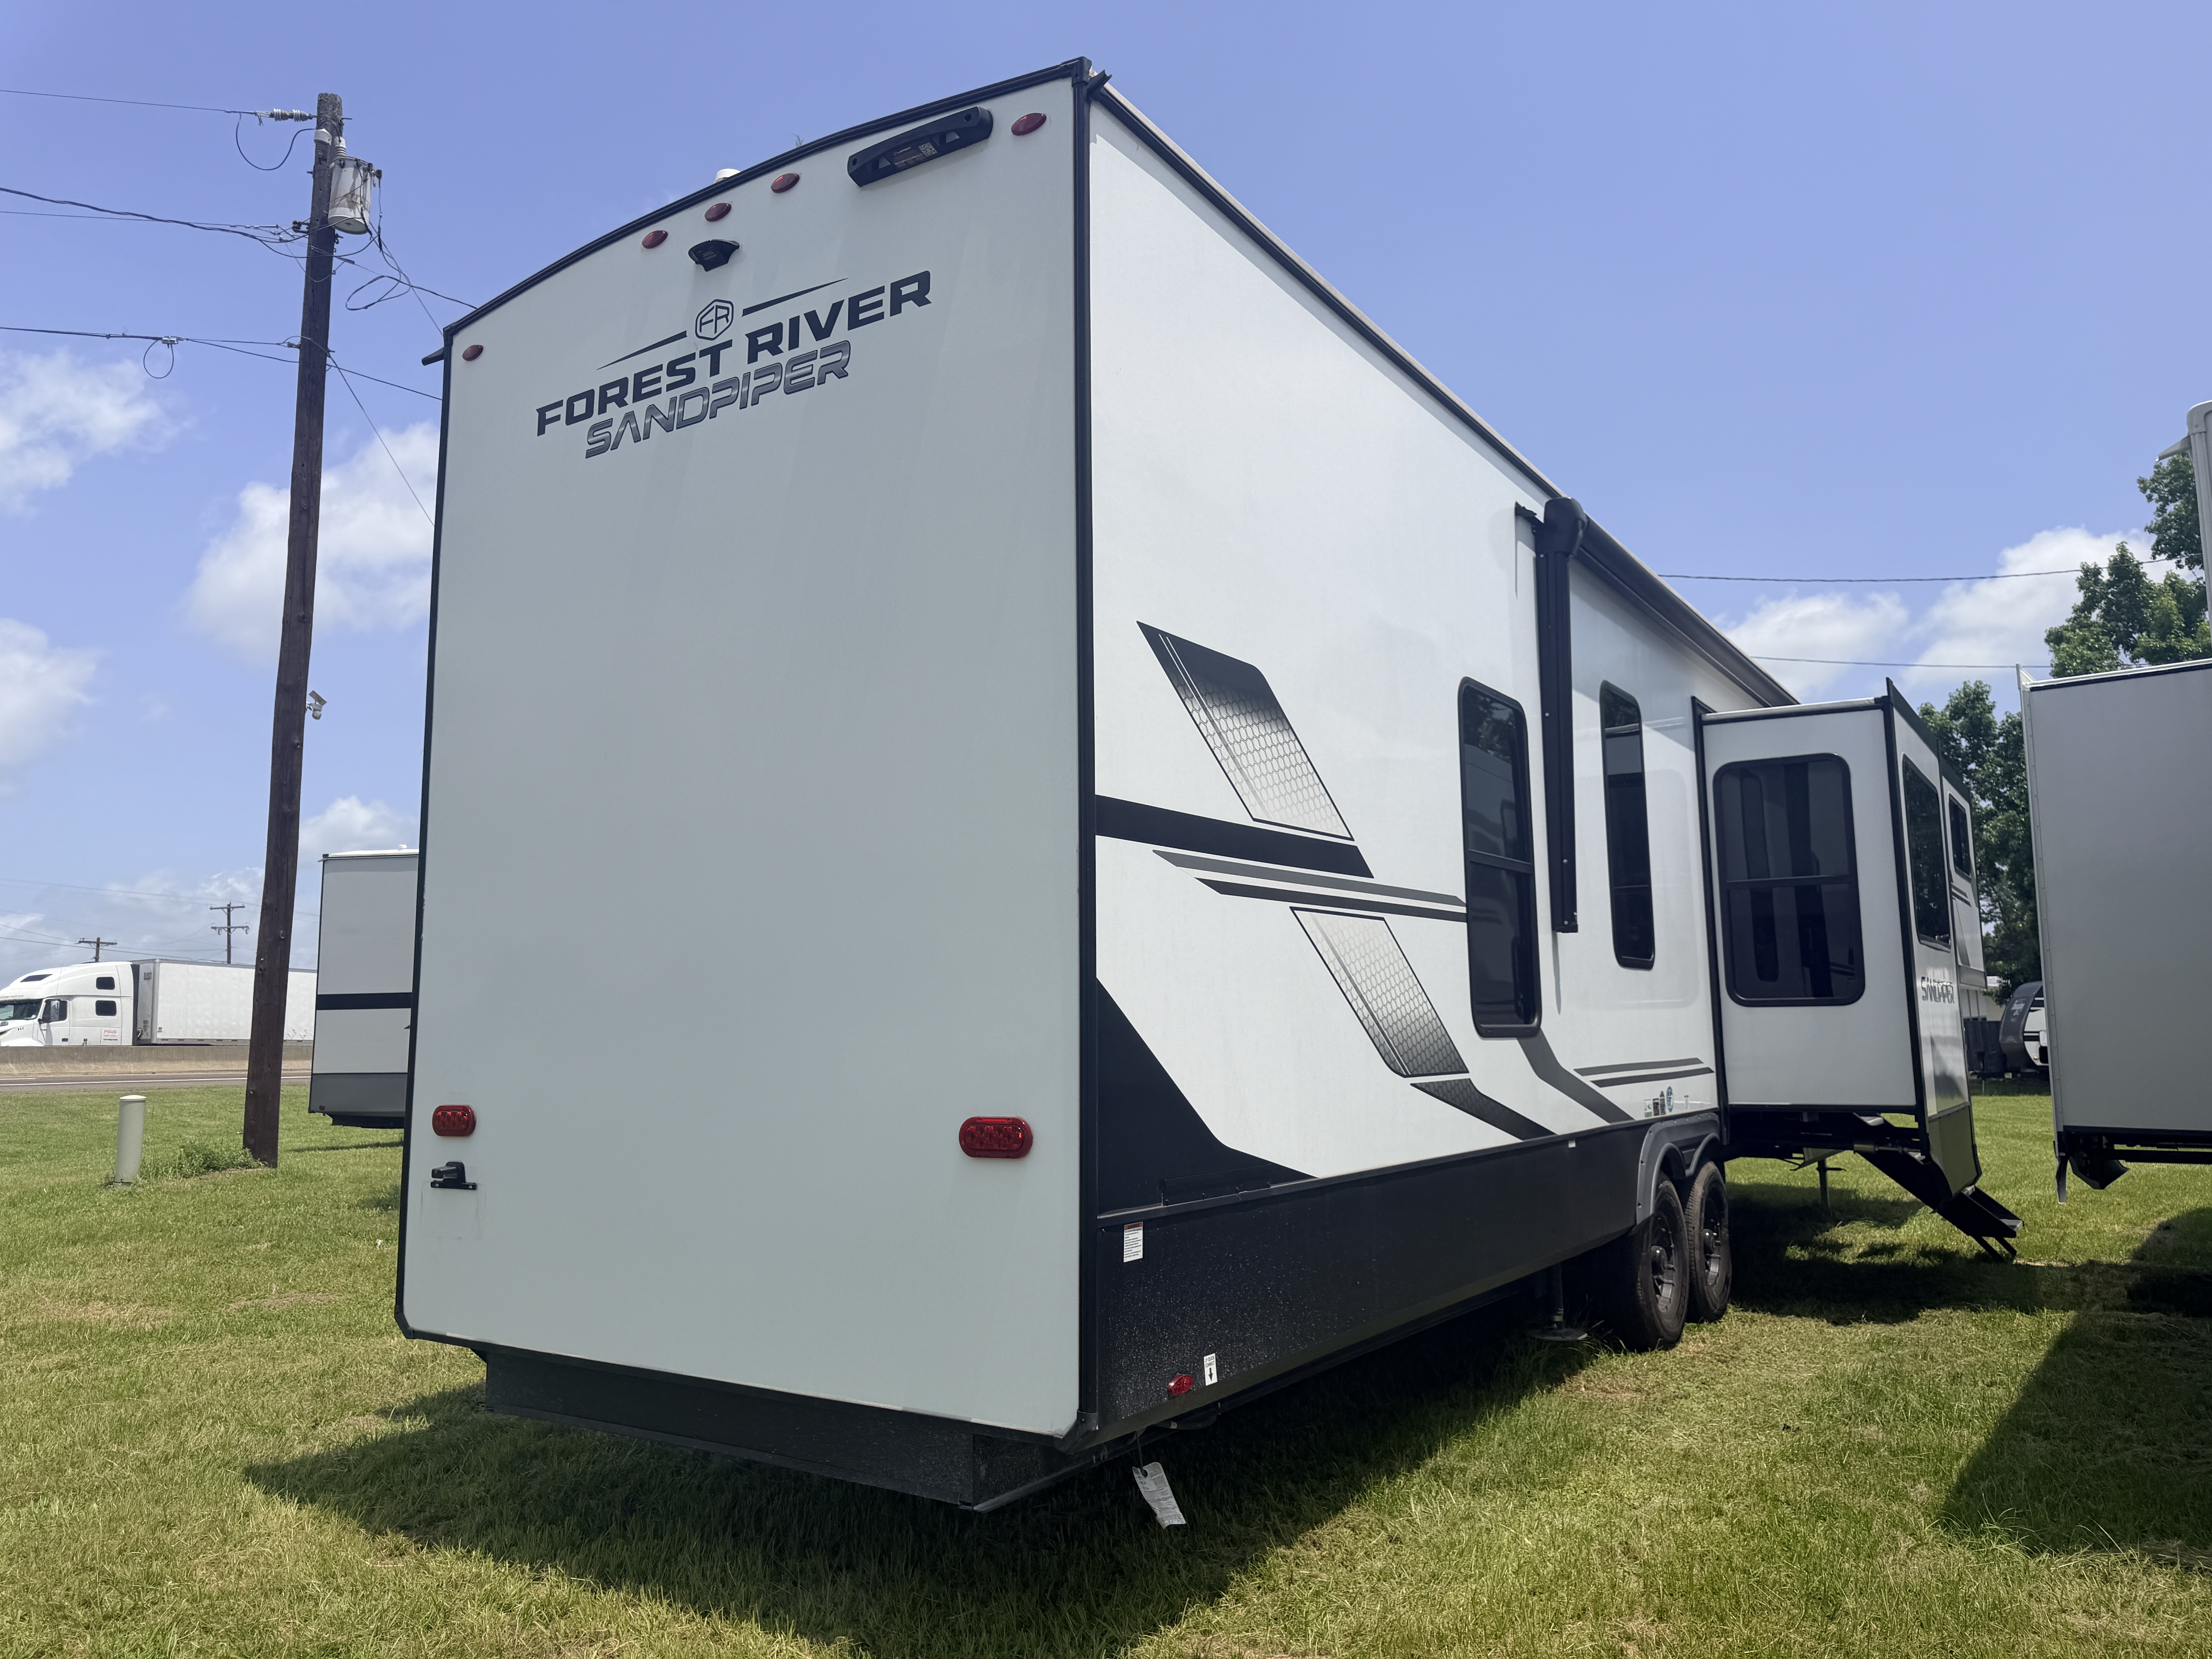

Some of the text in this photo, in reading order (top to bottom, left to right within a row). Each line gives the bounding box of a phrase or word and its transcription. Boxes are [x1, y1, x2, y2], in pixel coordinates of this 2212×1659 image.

[536, 270, 932, 436] FOREST RIVER
[585, 340, 851, 459] SANDPIPER
